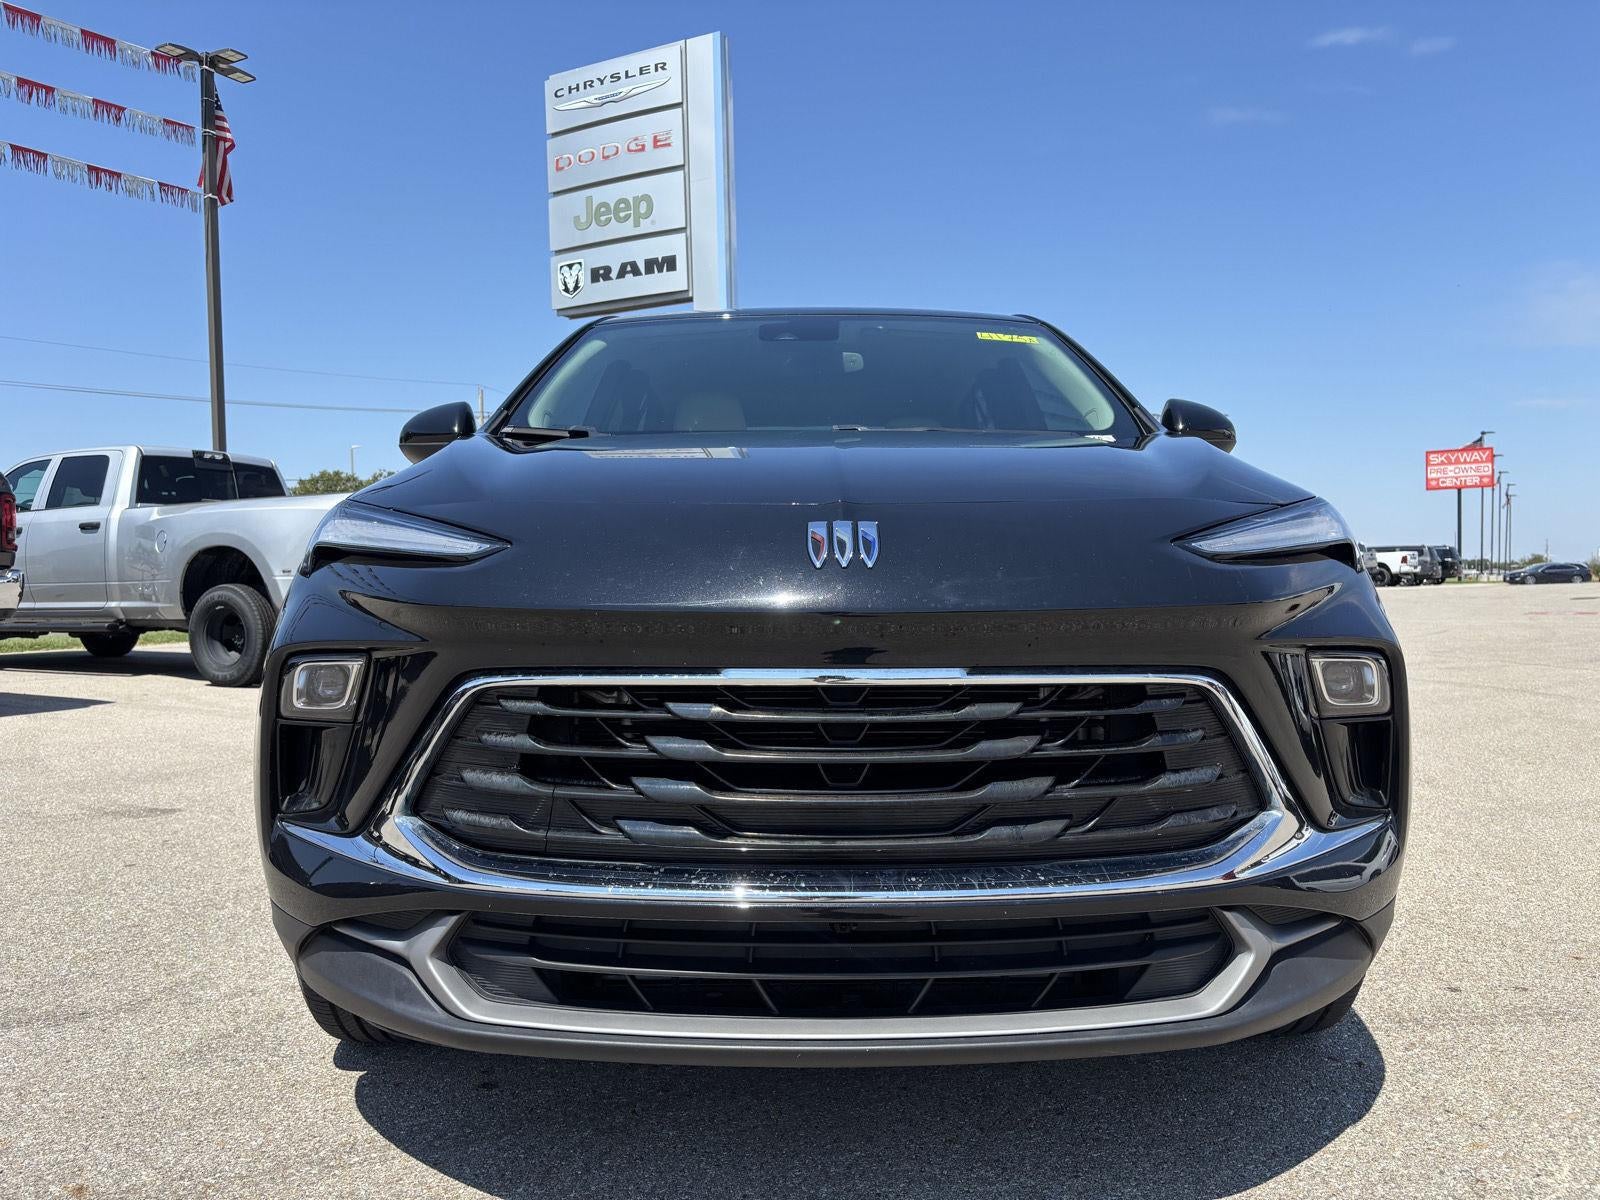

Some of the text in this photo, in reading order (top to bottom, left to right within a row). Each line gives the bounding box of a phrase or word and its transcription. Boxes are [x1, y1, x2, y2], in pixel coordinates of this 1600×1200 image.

[554, 61, 667, 98] CHRYSLER
[555, 130, 673, 172] DODGE
[573, 193, 654, 231] Jeep
[590, 254, 677, 284] RAM
[1429, 465, 1490, 475] PRE-OWNED
[1439, 476, 1480, 487] CENTER
